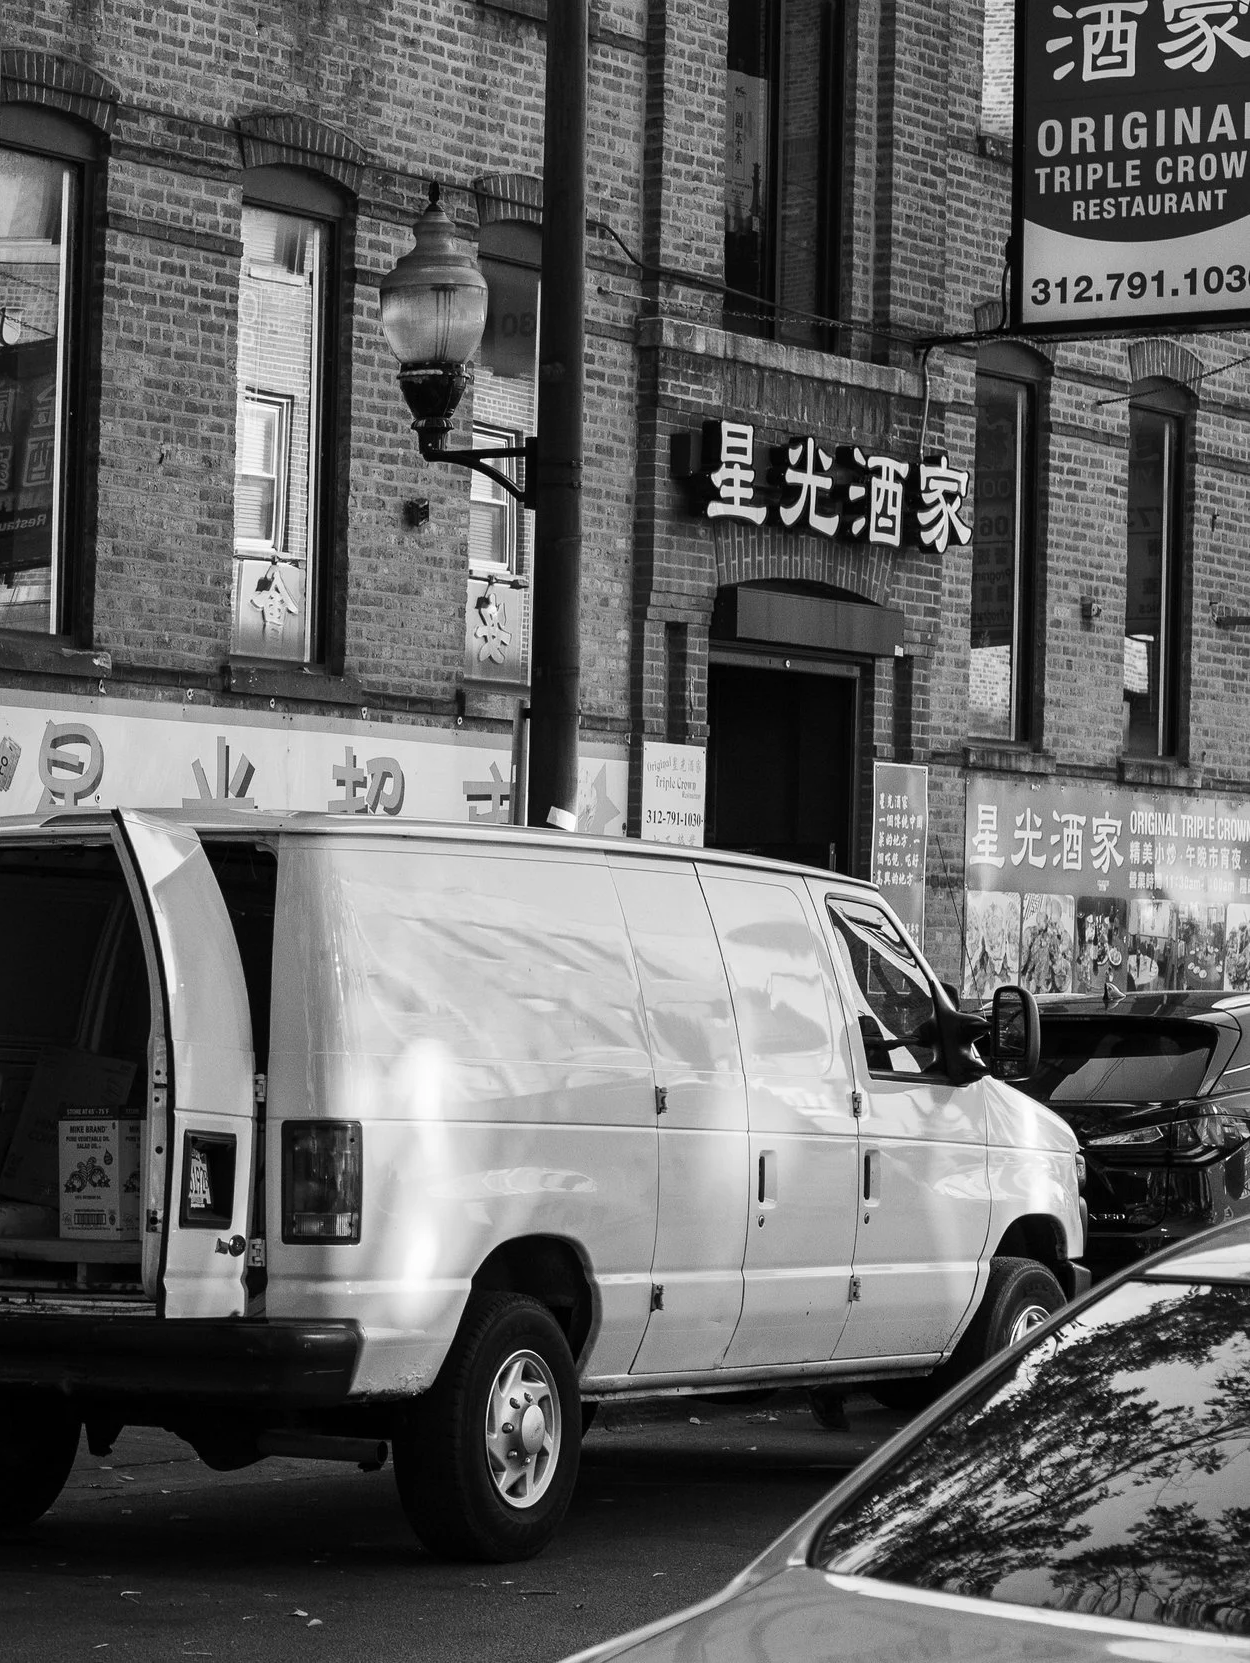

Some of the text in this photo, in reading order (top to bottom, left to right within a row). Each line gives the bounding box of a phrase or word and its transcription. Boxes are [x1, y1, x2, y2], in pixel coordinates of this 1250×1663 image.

[1035, 159, 1142, 194] TRIPLE
[1072, 189, 1228, 222] RESTAURANT
[1031, 263, 1250, 306] 312.791.103
[707, 420, 972, 553] 星光酒家
[655, 775, 697, 791] Triple Crown
[969, 803, 1125, 874] 星光酒家
[1129, 810, 1179, 837] ORIGINAL
[1180, 814, 1216, 840] TRIPLE
[69, 1125, 106, 1133] MIKE BRAND
